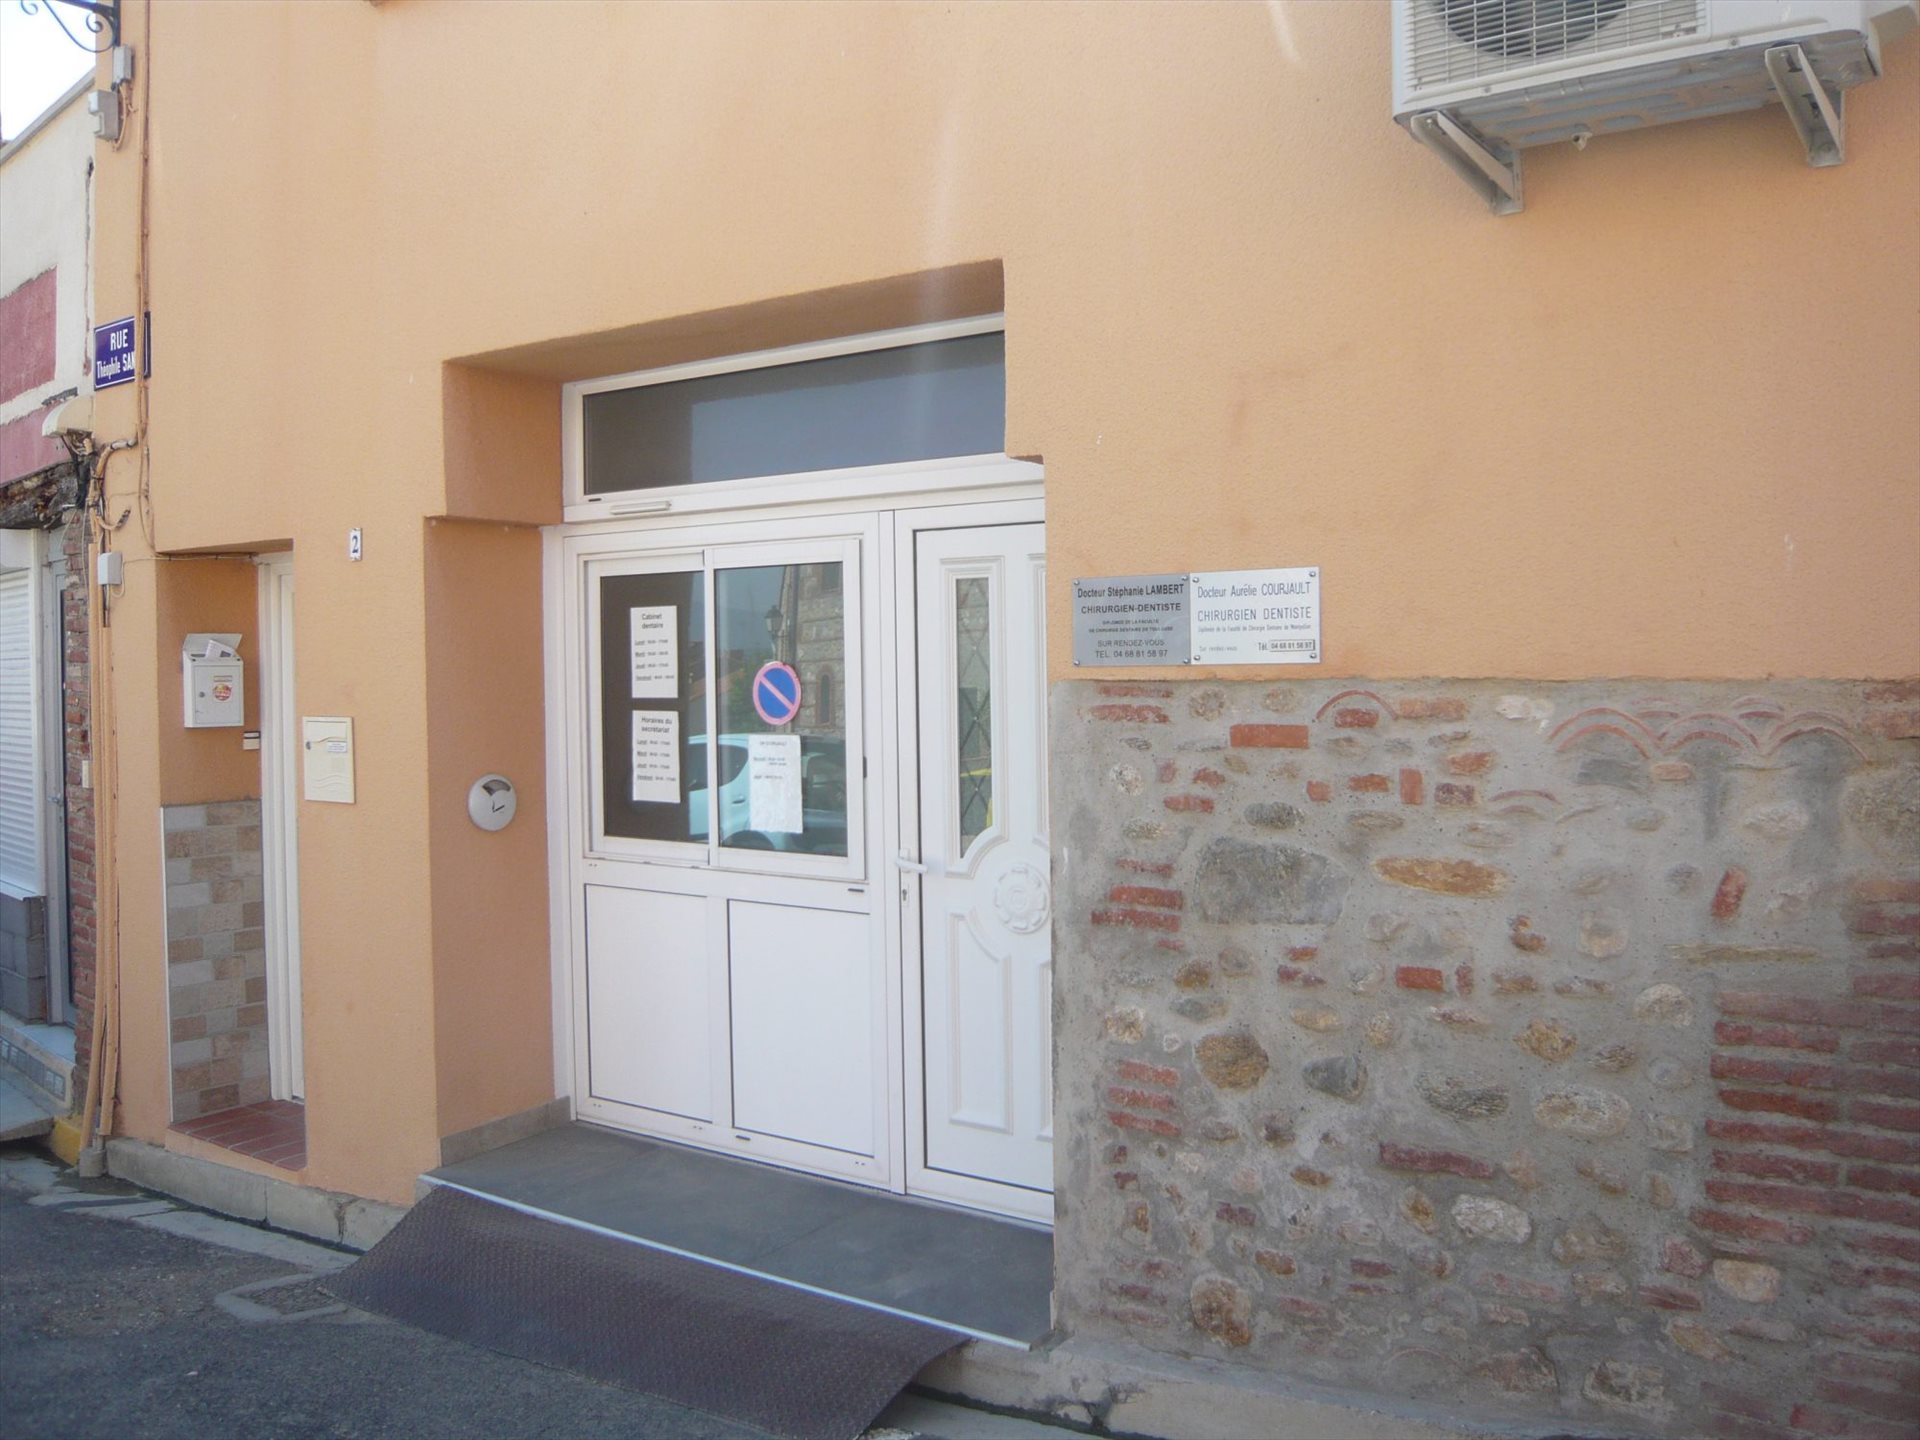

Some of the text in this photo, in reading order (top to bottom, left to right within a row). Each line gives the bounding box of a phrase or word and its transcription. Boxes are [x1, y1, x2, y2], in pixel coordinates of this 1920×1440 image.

[110, 329, 128, 351] RUE
[352, 535, 359, 554] 2
[1077, 584, 1184, 598] Docteur Stéphanie LAMBERT
[1197, 582, 1311, 598] Docteur Aurélie COURJAULT
[1081, 603, 1181, 614] CHIRURGIEN-DENTISTE
[1197, 607, 1312, 621] CHIRURGIEN DENTISTE
[1098, 639, 1165, 648] SUR RENDEZ-VOUS
[1113, 650, 1123, 658] 04
[1158, 649, 1168, 657] 97
